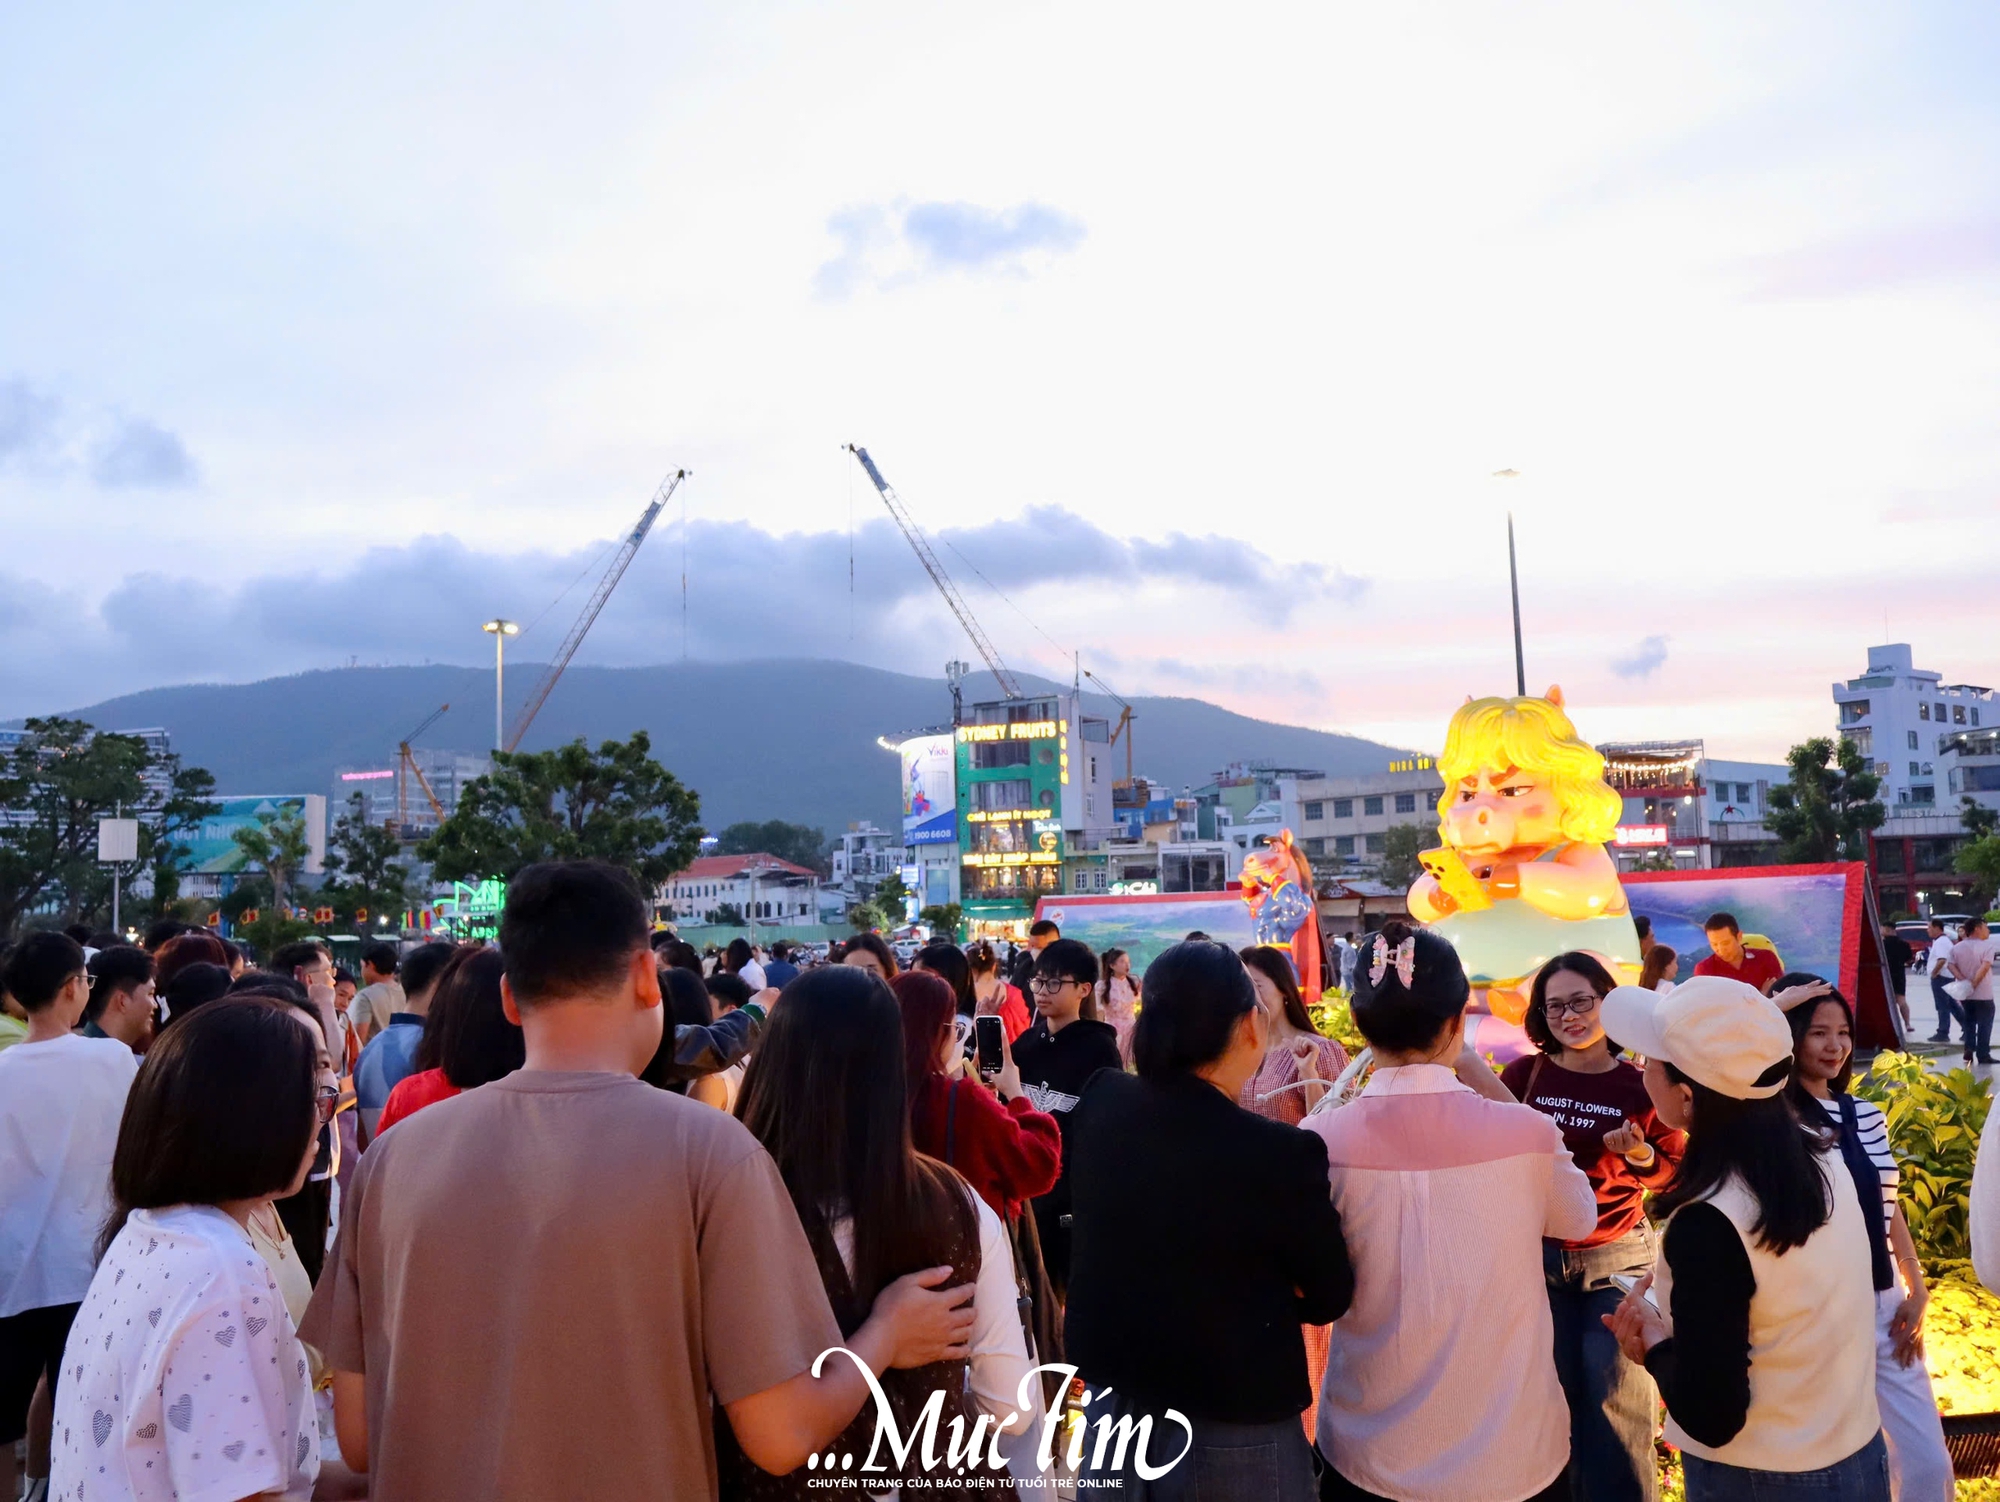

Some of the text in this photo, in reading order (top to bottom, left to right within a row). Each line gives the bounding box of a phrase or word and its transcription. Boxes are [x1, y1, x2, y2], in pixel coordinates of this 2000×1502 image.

[959, 721, 1057, 742] SYDNEY FRUITS
[1535, 1096, 1622, 1117] AUGUST FLOWERS
[1569, 1116, 1596, 1129] 1997
